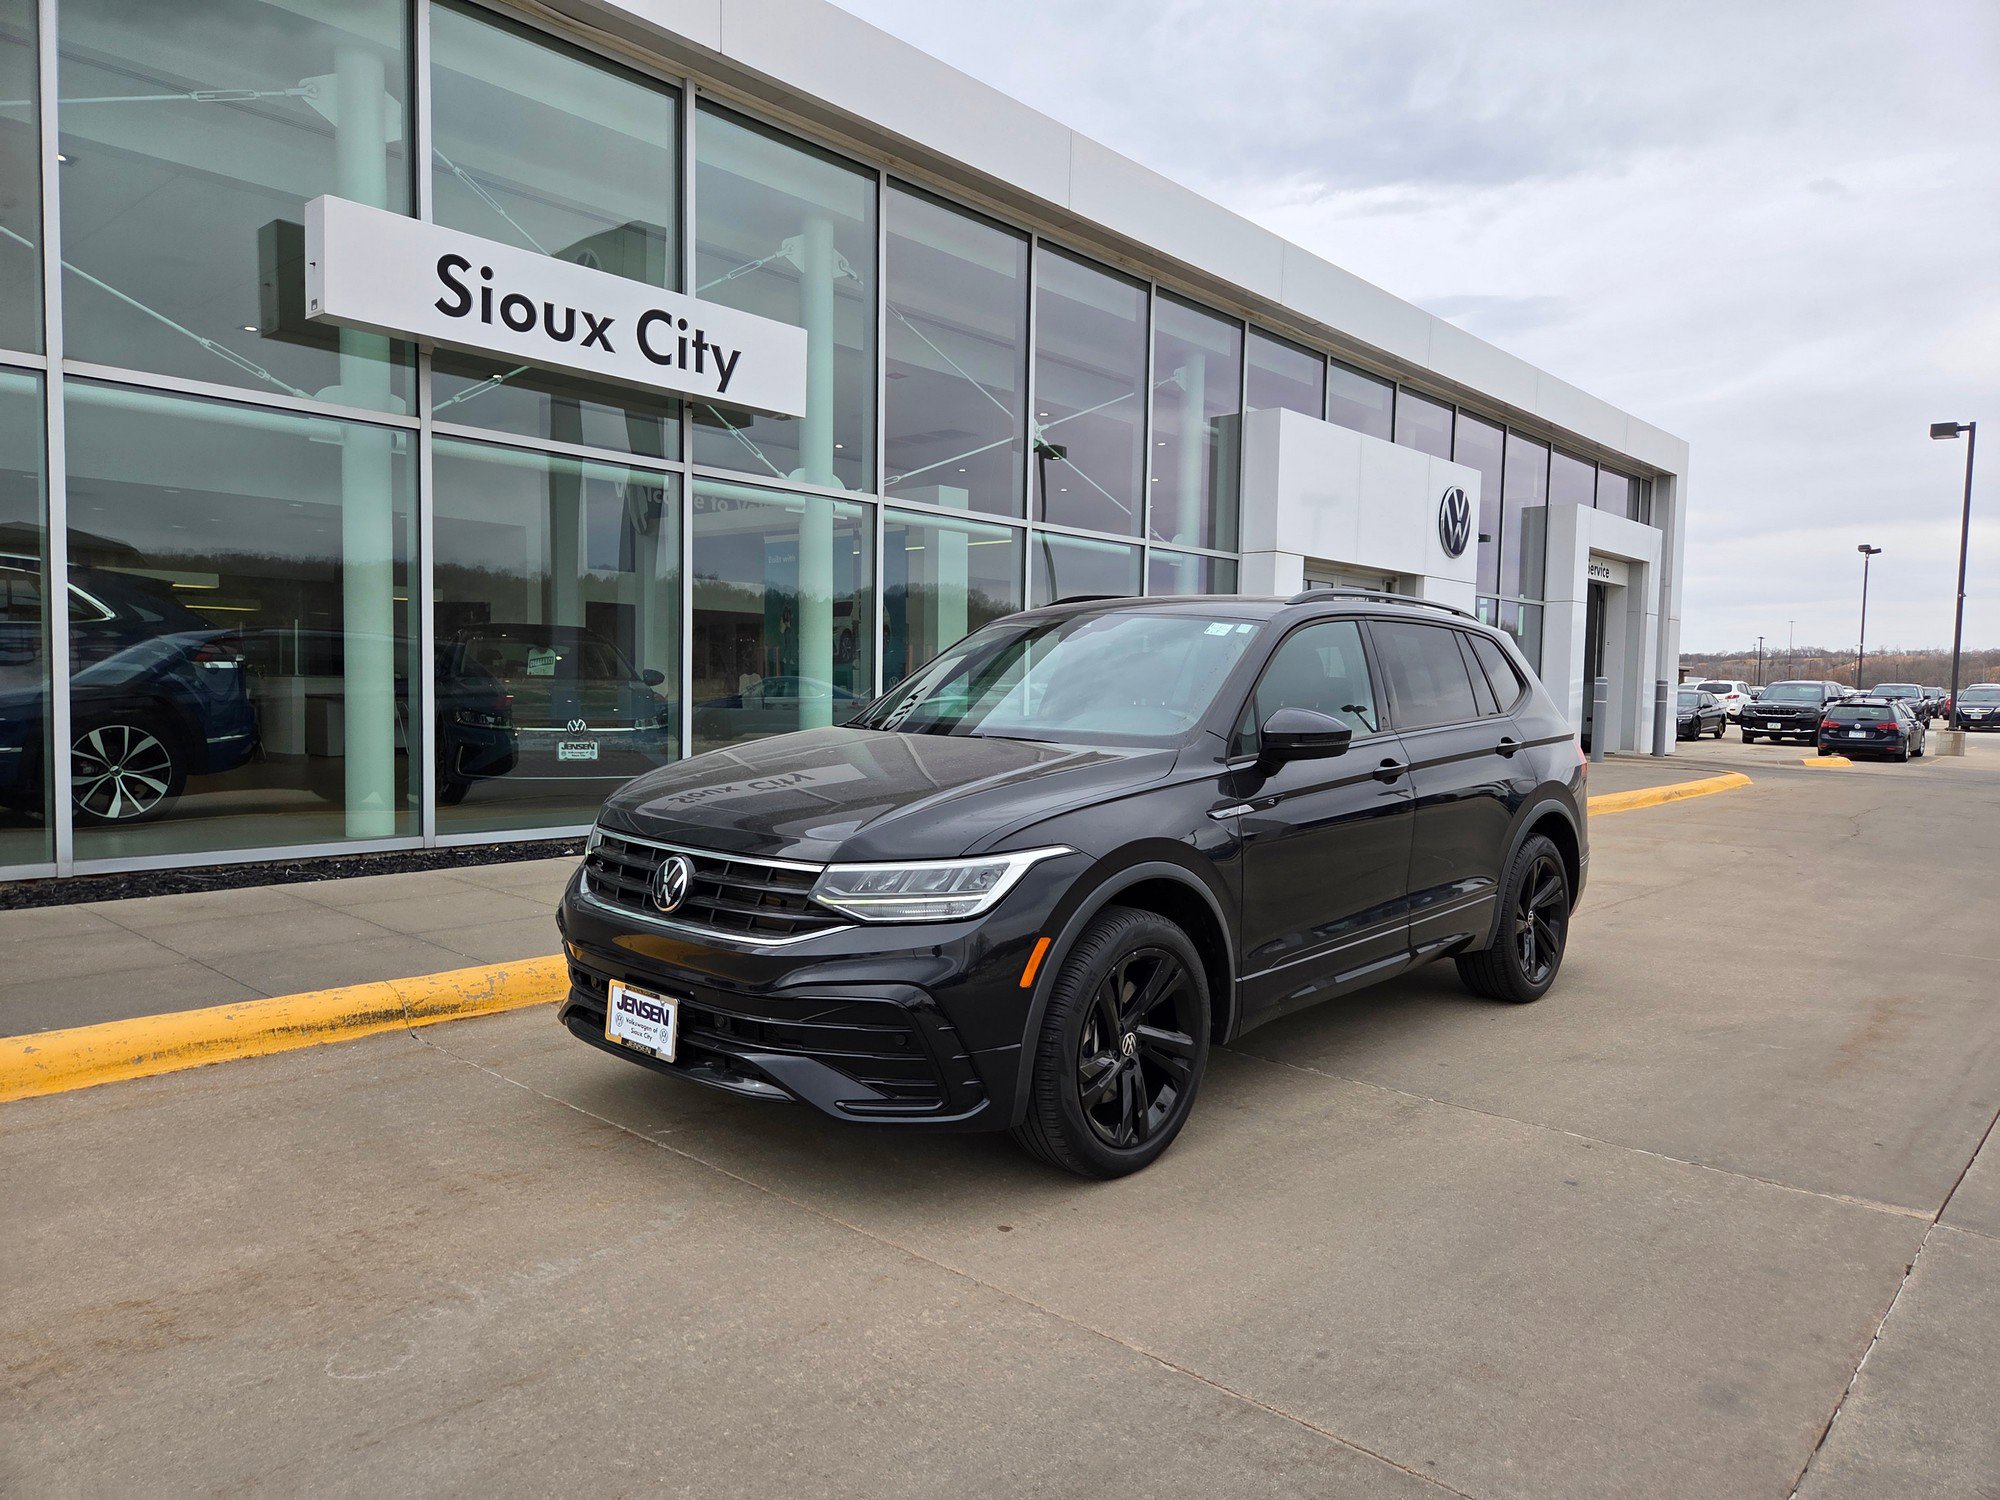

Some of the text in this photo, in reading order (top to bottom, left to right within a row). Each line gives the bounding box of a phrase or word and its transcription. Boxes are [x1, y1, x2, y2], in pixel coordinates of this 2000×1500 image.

[434, 253, 742, 393] Sioux City
[782, 554, 796, 563] with
[561, 743, 595, 751] JENSEN
[616, 993, 670, 1027] JENSEN
[626, 1017, 653, 1032] Volkswagen
[630, 1028, 653, 1041] Sioux City
[626, 1041, 652, 1054] JENSEN
